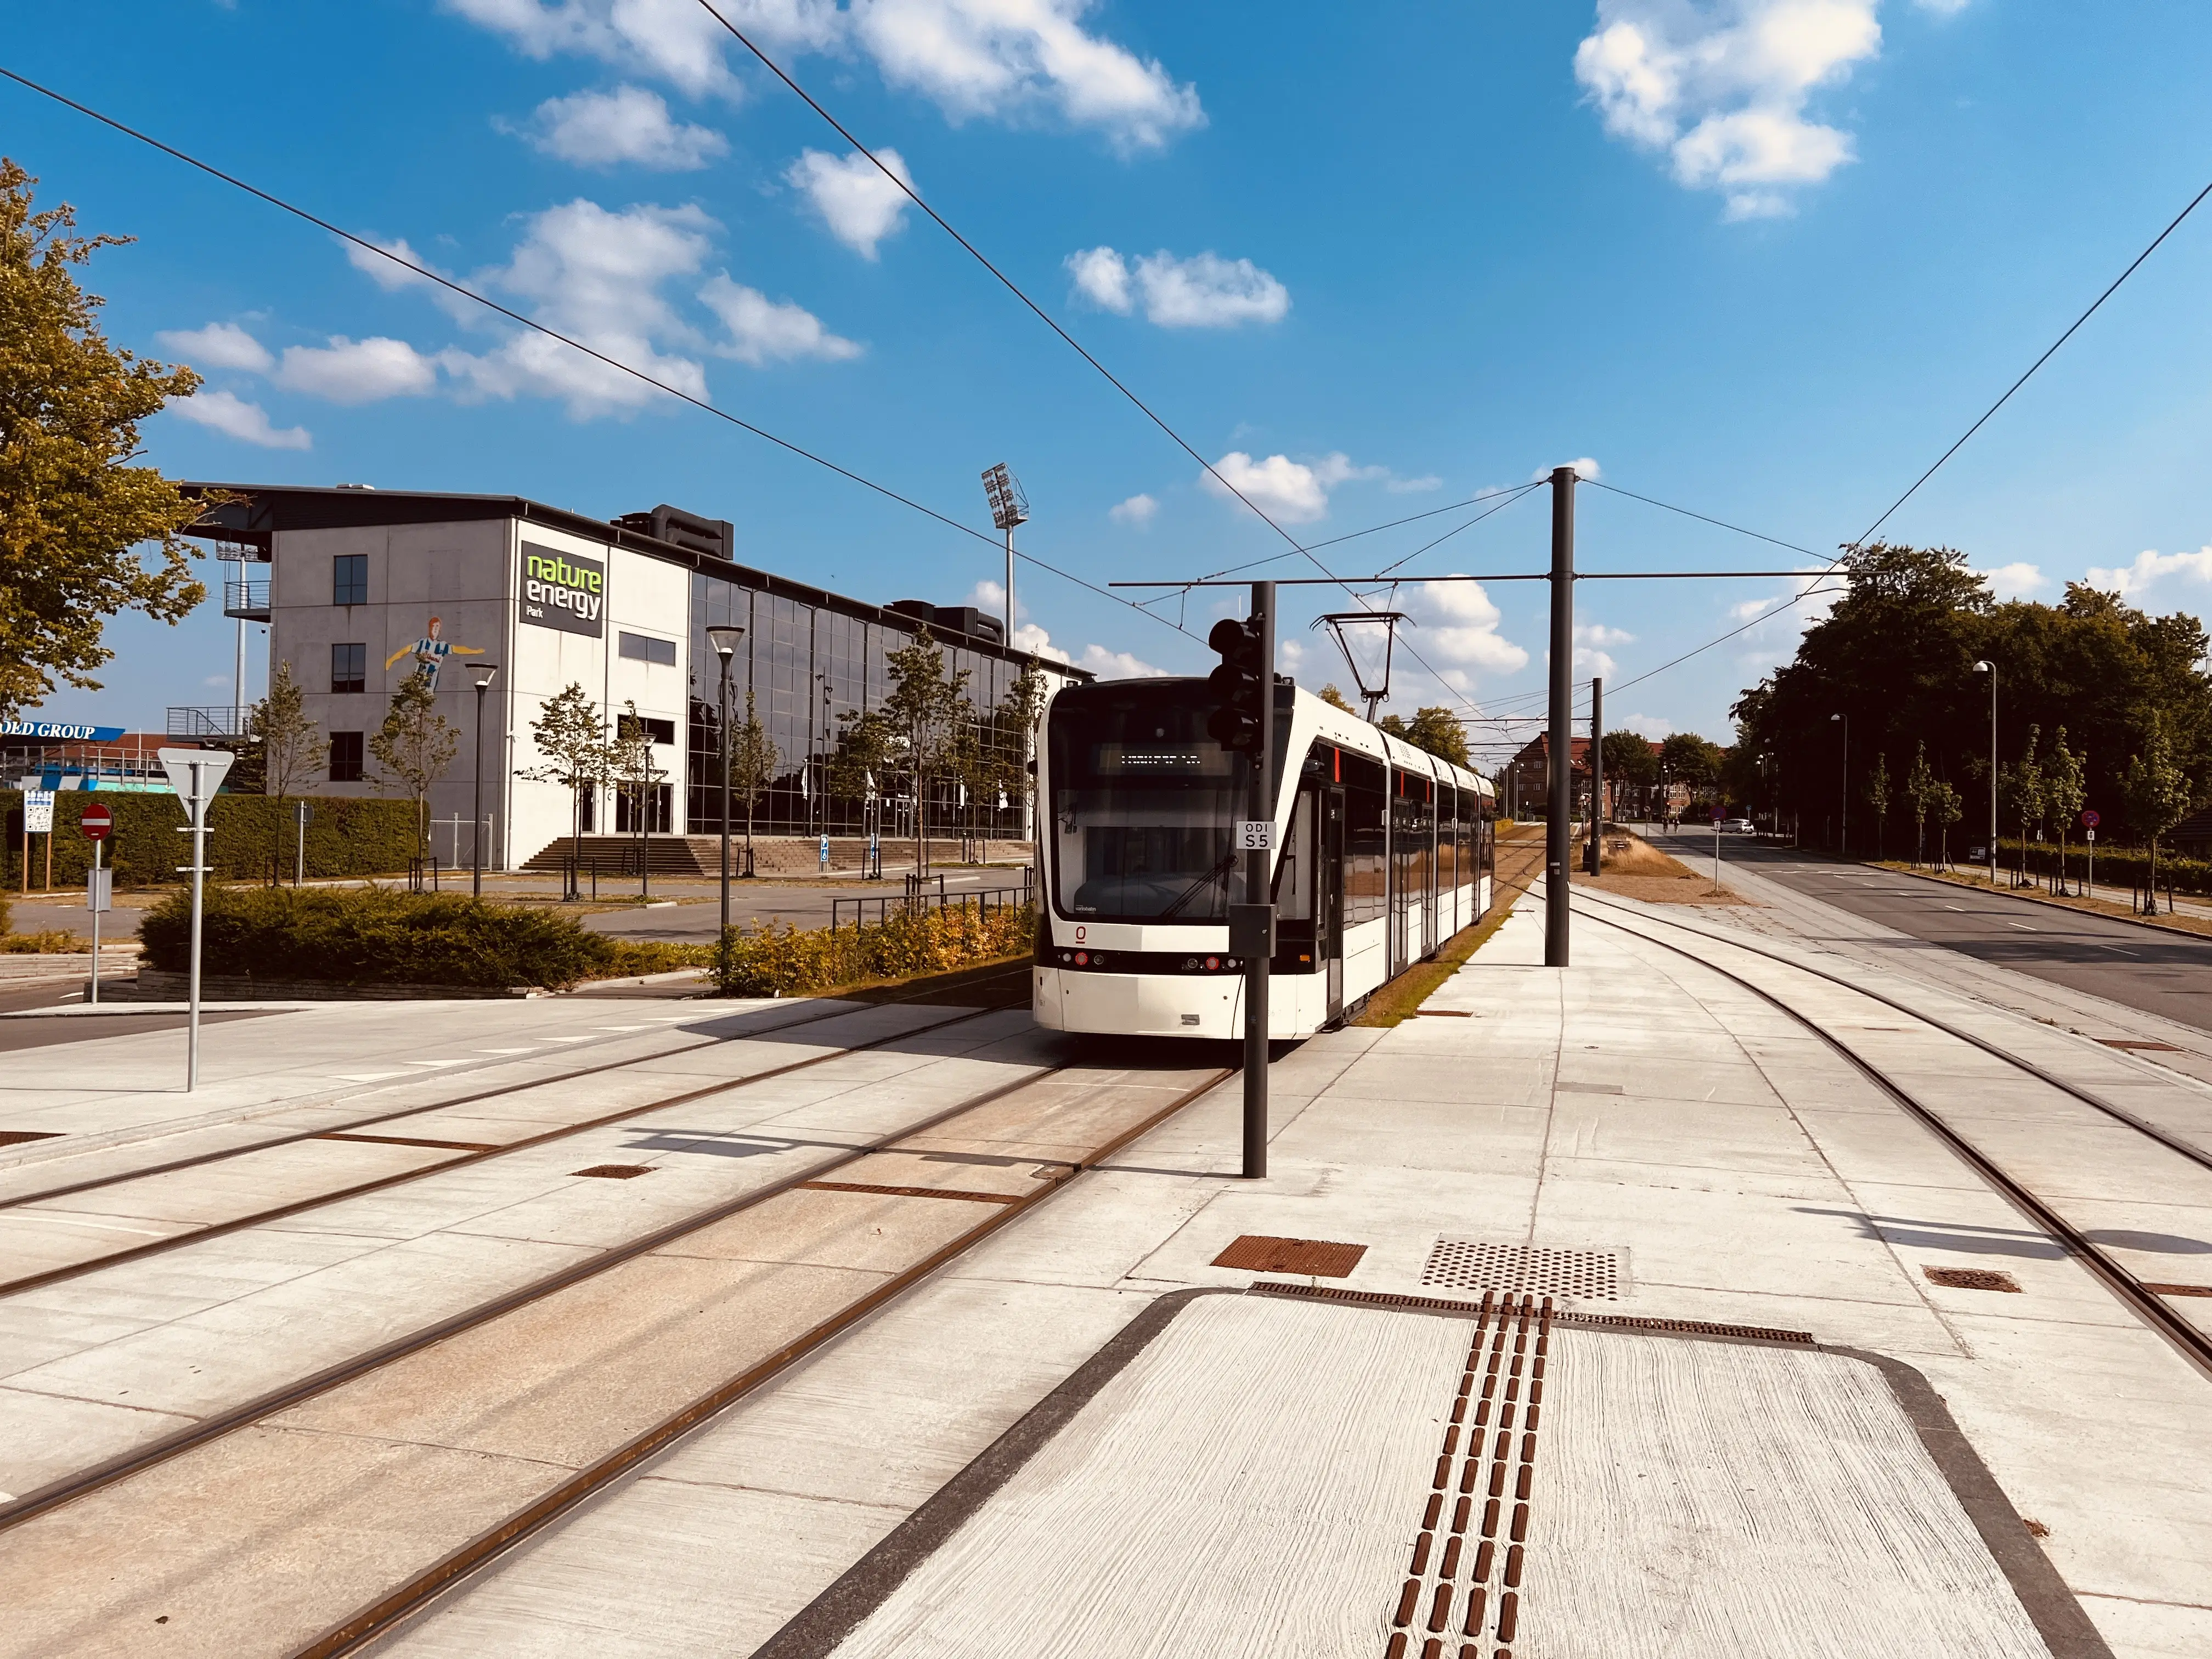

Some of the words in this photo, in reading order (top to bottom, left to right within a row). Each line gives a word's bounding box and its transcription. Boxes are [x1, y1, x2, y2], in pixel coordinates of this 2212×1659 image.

[527, 556, 602, 594] nature
[526, 580, 601, 621] energy
[526, 605, 544, 619] Park
[37, 723, 95, 740] GROUP
[1245, 823, 1267, 832] ODI
